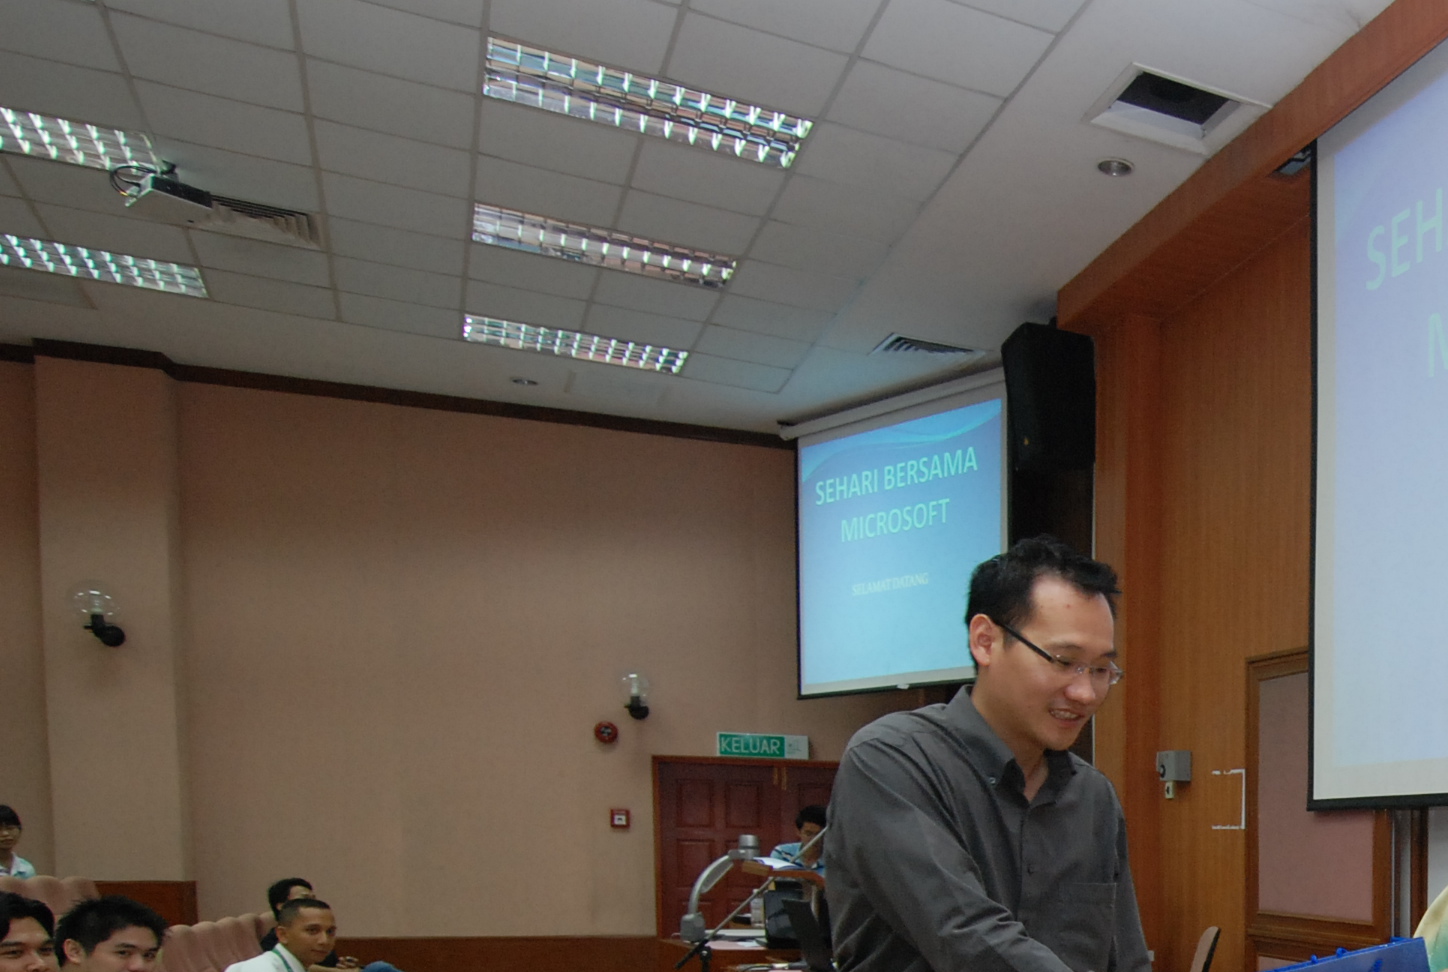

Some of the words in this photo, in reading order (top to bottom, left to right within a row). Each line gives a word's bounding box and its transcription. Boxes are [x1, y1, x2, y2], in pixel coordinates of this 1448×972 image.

[815, 468, 878, 506] SEHARI
[884, 446, 978, 490] BERSAMA
[841, 498, 950, 543] MICROSOFT
[720, 736, 781, 755] KELUAR
